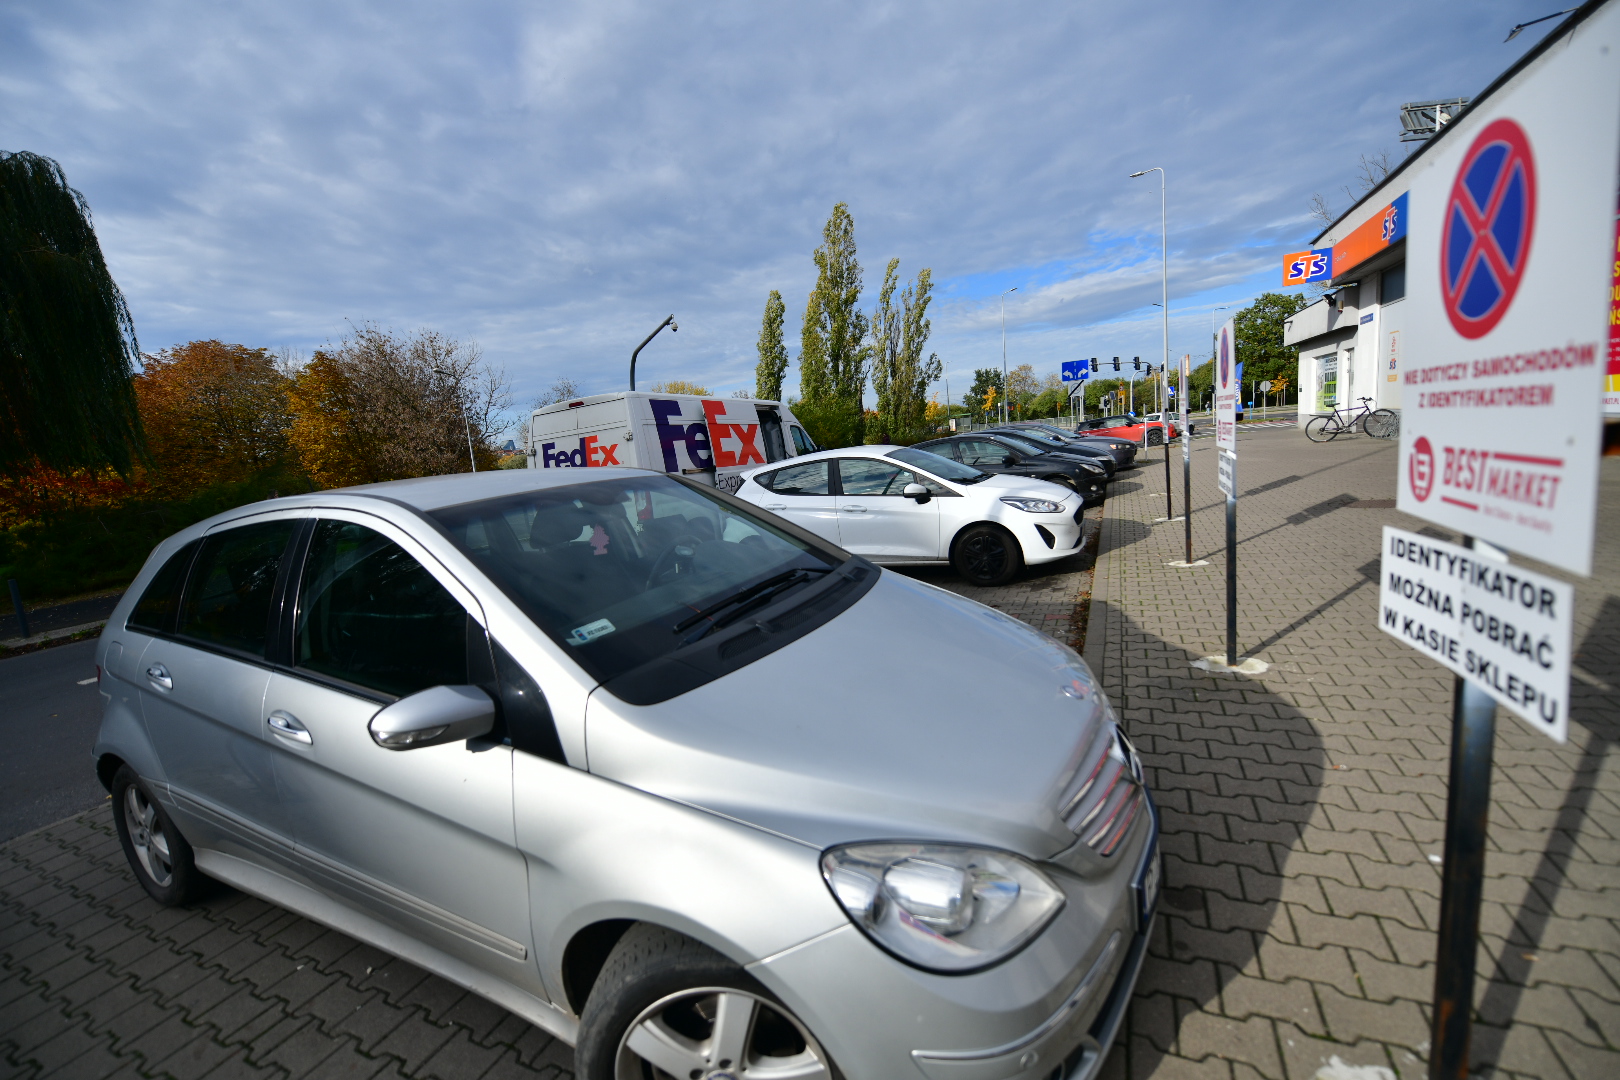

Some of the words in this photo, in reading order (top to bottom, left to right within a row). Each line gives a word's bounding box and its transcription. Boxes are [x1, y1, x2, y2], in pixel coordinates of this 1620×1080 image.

[1381, 206, 1398, 241] STS
[1288, 253, 1328, 279] STS
[1404, 369, 1418, 385] NIE
[1421, 362, 1468, 384] DOTYCZY
[1472, 340, 1598, 380] SAMOCHODÓW
[1418, 392, 1426, 408] Z
[1427, 384, 1555, 408] IDENTYFIKATOREM
[542, 435, 620, 468] FedEx
[649, 399, 767, 473] FeEx
[718, 472, 742, 491] Expr
[1443, 446, 1490, 493] BEST
[1487, 466, 1562, 510] MARKET
[1390, 536, 1557, 619] IDENTYFIKATOR
[1389, 573, 1454, 619] MOŻNA
[1461, 602, 1554, 670] POBRAĆ
[1384, 606, 1398, 629] W
[1402, 615, 1460, 663] KASIE
[1464, 648, 1558, 725] SKLEPU
